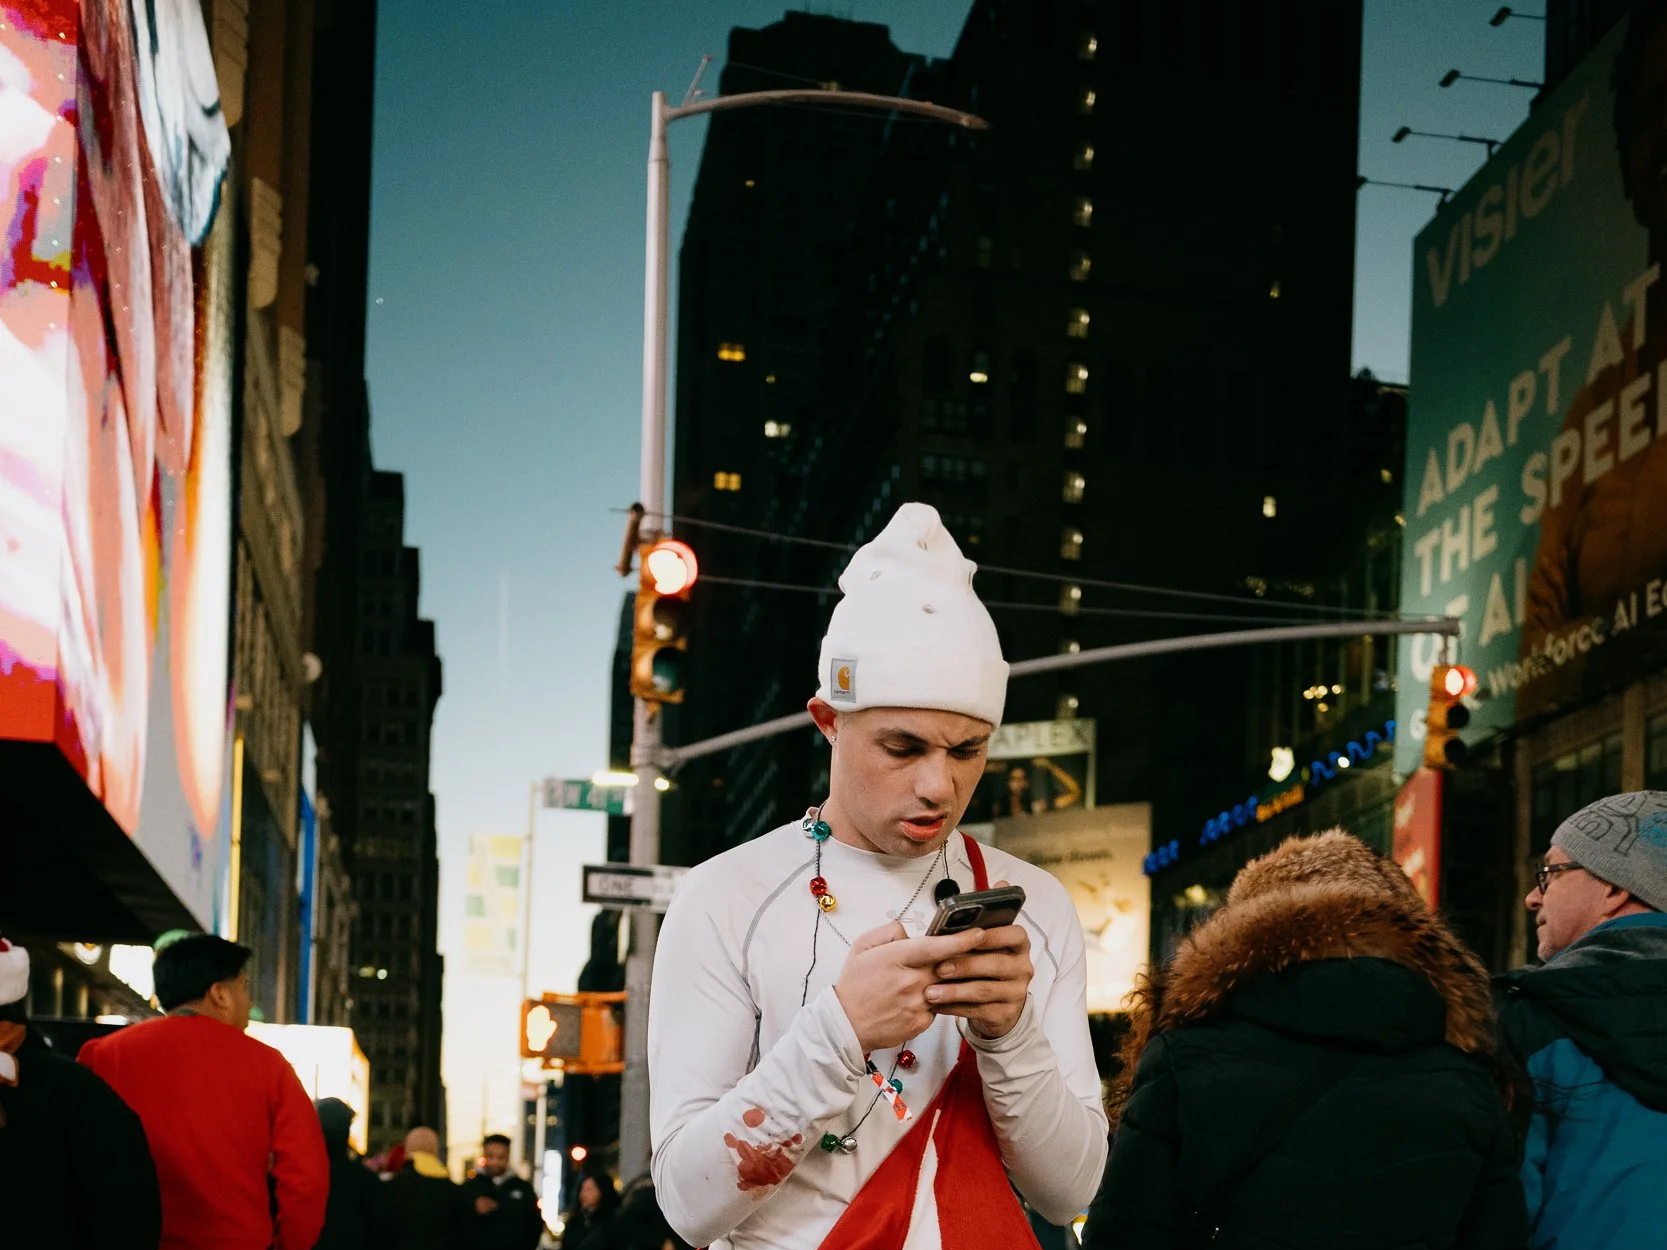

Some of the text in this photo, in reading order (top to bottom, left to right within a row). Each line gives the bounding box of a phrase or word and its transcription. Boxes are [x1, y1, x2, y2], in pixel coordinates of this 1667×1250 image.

[1417, 262, 1661, 517] ADAPT AT
[1415, 483, 1500, 597] THE
[1479, 557, 1527, 647] AI
[1488, 616, 1606, 698] Workforce
[1611, 592, 1638, 636] AI
